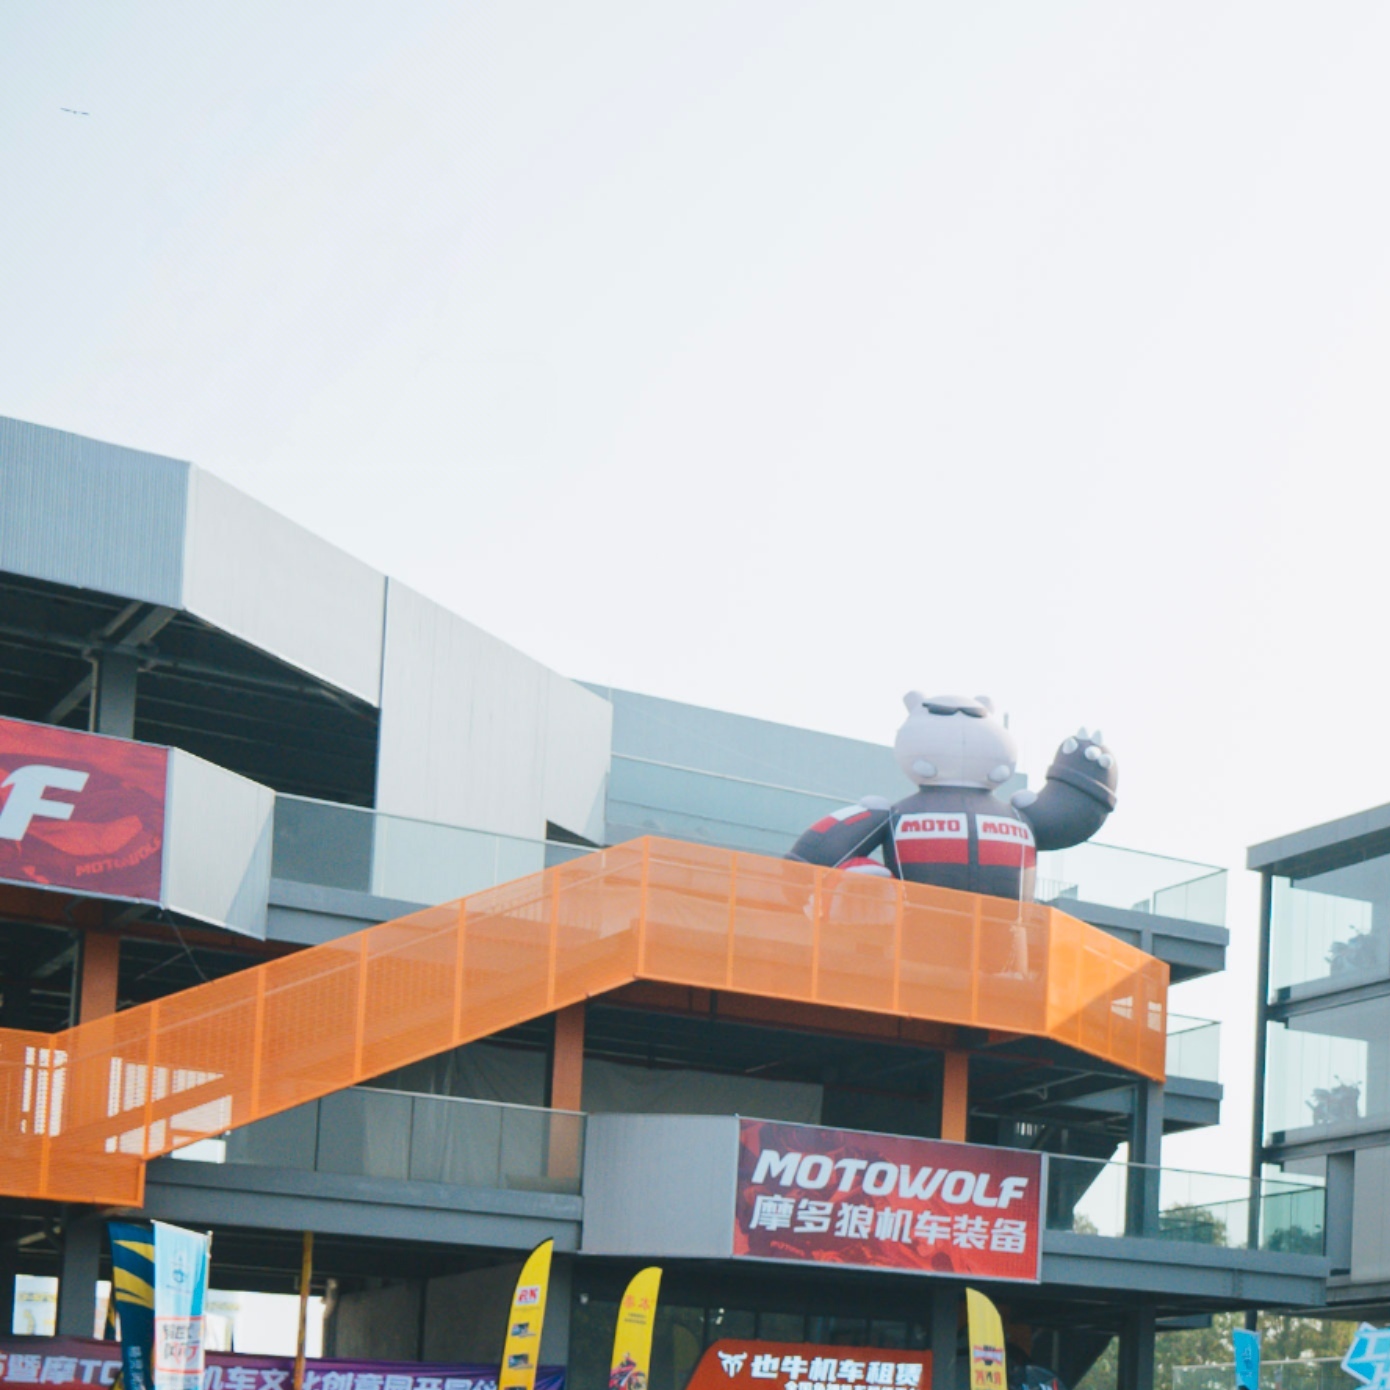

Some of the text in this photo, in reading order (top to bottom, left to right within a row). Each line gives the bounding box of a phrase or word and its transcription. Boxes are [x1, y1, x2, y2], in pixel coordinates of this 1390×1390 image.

[0, 764, 90, 841] F
[900, 819, 960, 834] MOTO
[981, 820, 1029, 840] MOTO
[751, 1149, 1029, 1209] MOTOWOLF
[749, 1194, 1027, 1254] 摩多狼机车装备
[750, 1353, 923, 1386] 也牛机车租赁
